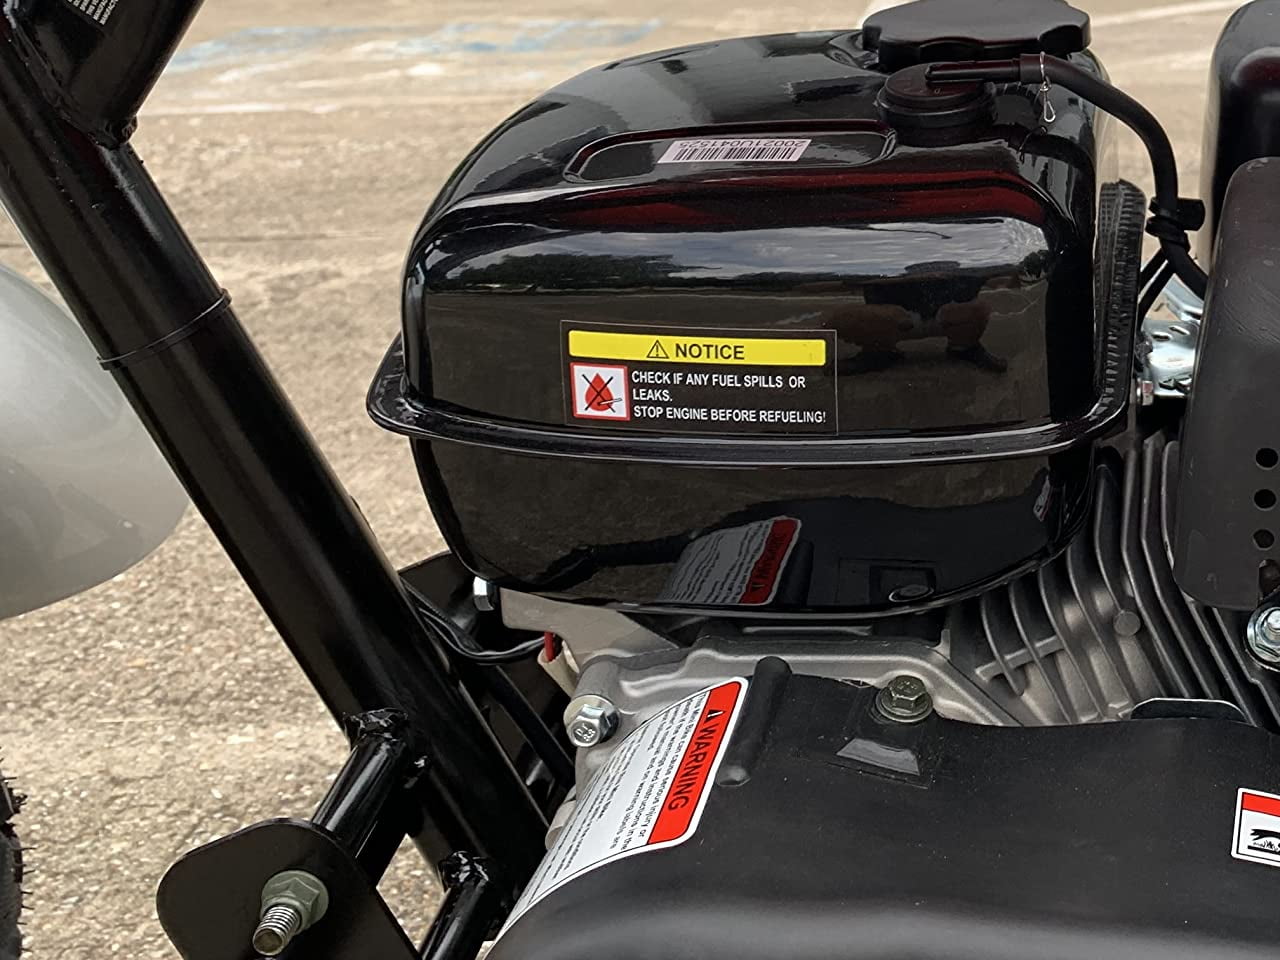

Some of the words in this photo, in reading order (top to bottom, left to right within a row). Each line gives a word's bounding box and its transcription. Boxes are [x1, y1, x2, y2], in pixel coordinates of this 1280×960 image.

[675, 344, 745, 359] NOTICE
[632, 371, 670, 384] CHECK
[673, 373, 684, 384] IF
[686, 374, 709, 385] ANY
[712, 375, 741, 387] FUEL
[744, 376, 783, 388] SPILLS
[789, 376, 806, 388] OR
[633, 389, 673, 401] LEAKS.
[634, 407, 662, 418] STOP
[666, 409, 708, 420] ENGINE
[711, 410, 757, 421] BEFORE
[760, 411, 826, 422] REFUELING!
[668, 724, 721, 811] WARNING
